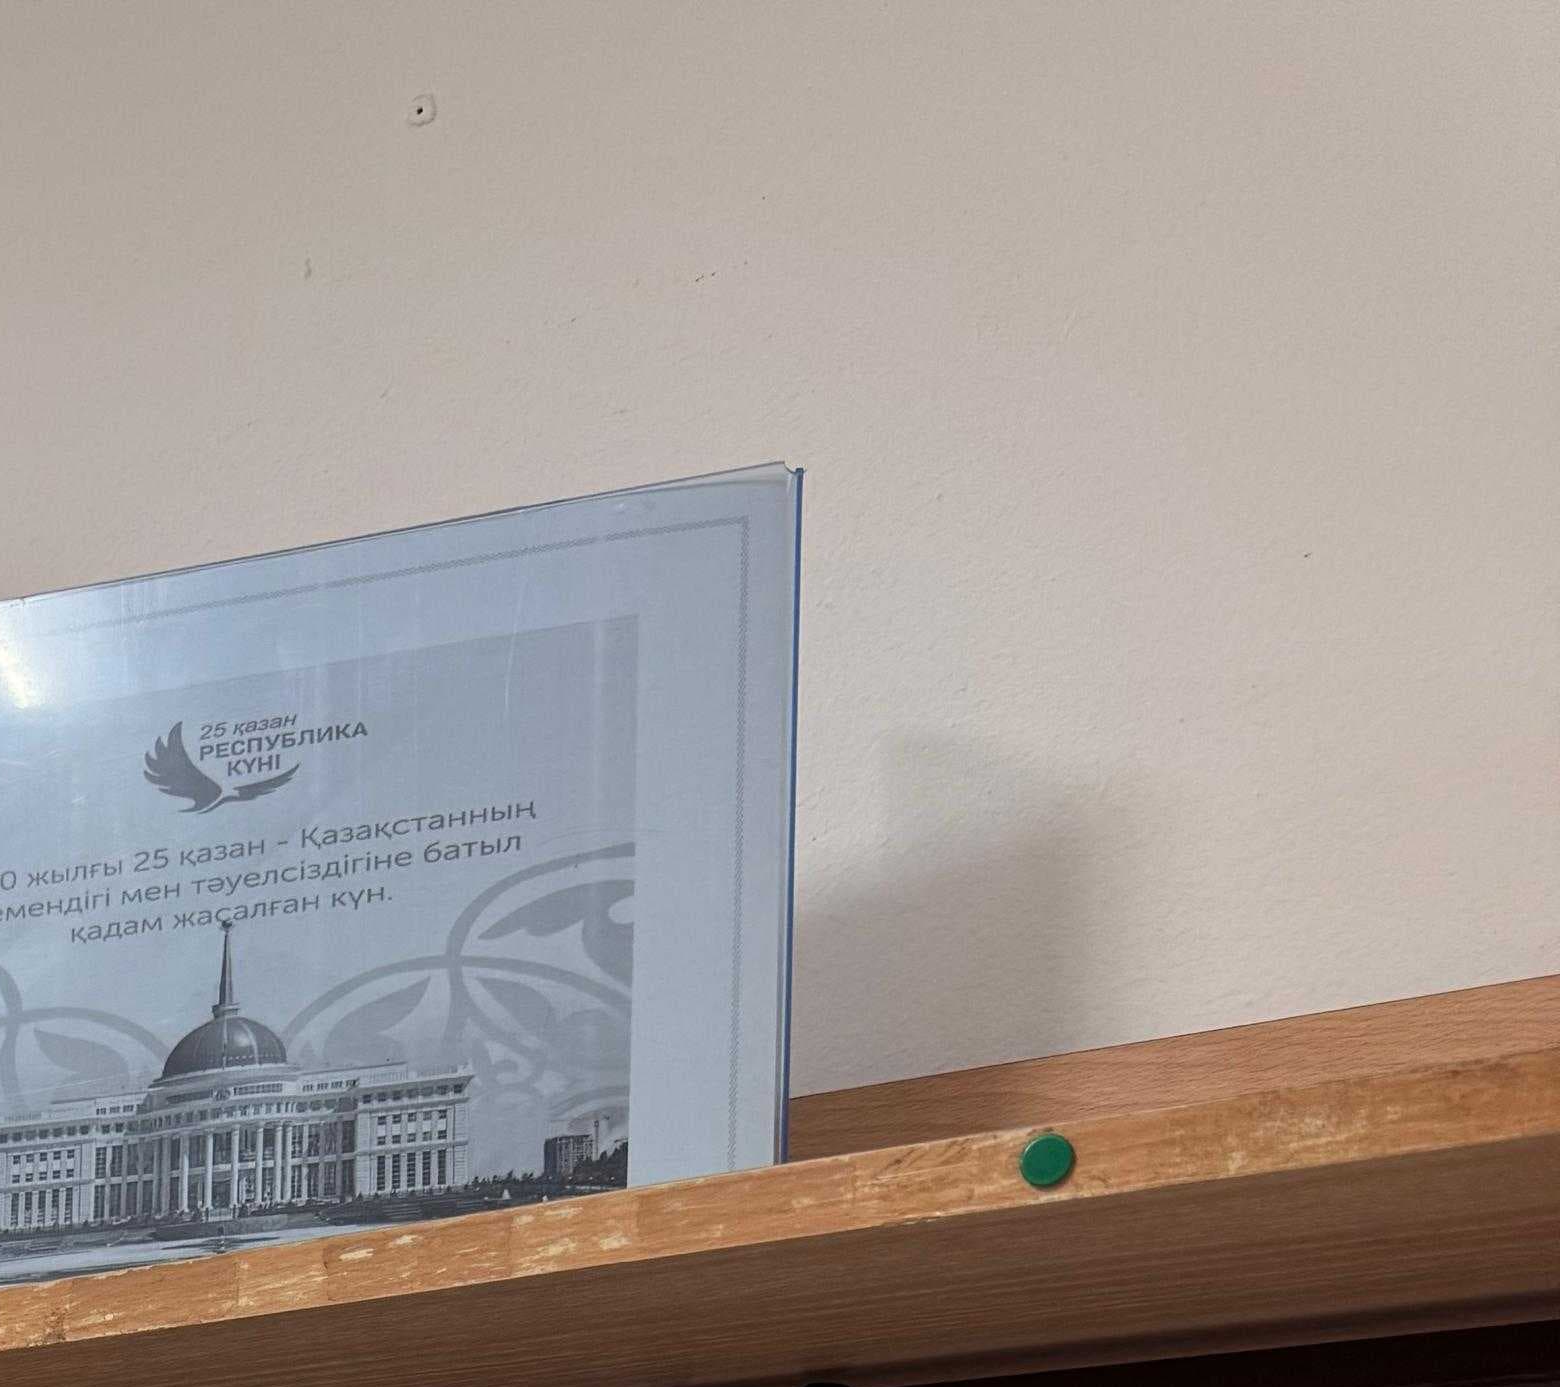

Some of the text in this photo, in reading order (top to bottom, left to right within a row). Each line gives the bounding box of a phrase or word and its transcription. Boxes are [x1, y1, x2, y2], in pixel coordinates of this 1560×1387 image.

[199, 721, 368, 761] РЕСПУБЛИКА
[200, 713, 297, 740] 25 қазан
[227, 754, 281, 776] КҮНІ
[27, 860, 123, 889] жылғы
[134, 848, 169, 872] 25
[180, 839, 265, 867] қазан
[301, 801, 537, 850] Қазақстанның
[121, 882, 180, 906] мен
[192, 850, 412, 896] тәуелсіздігіне
[424, 835, 521, 863] батыл
[71, 886, 393, 944] қадам жасалған күн.
